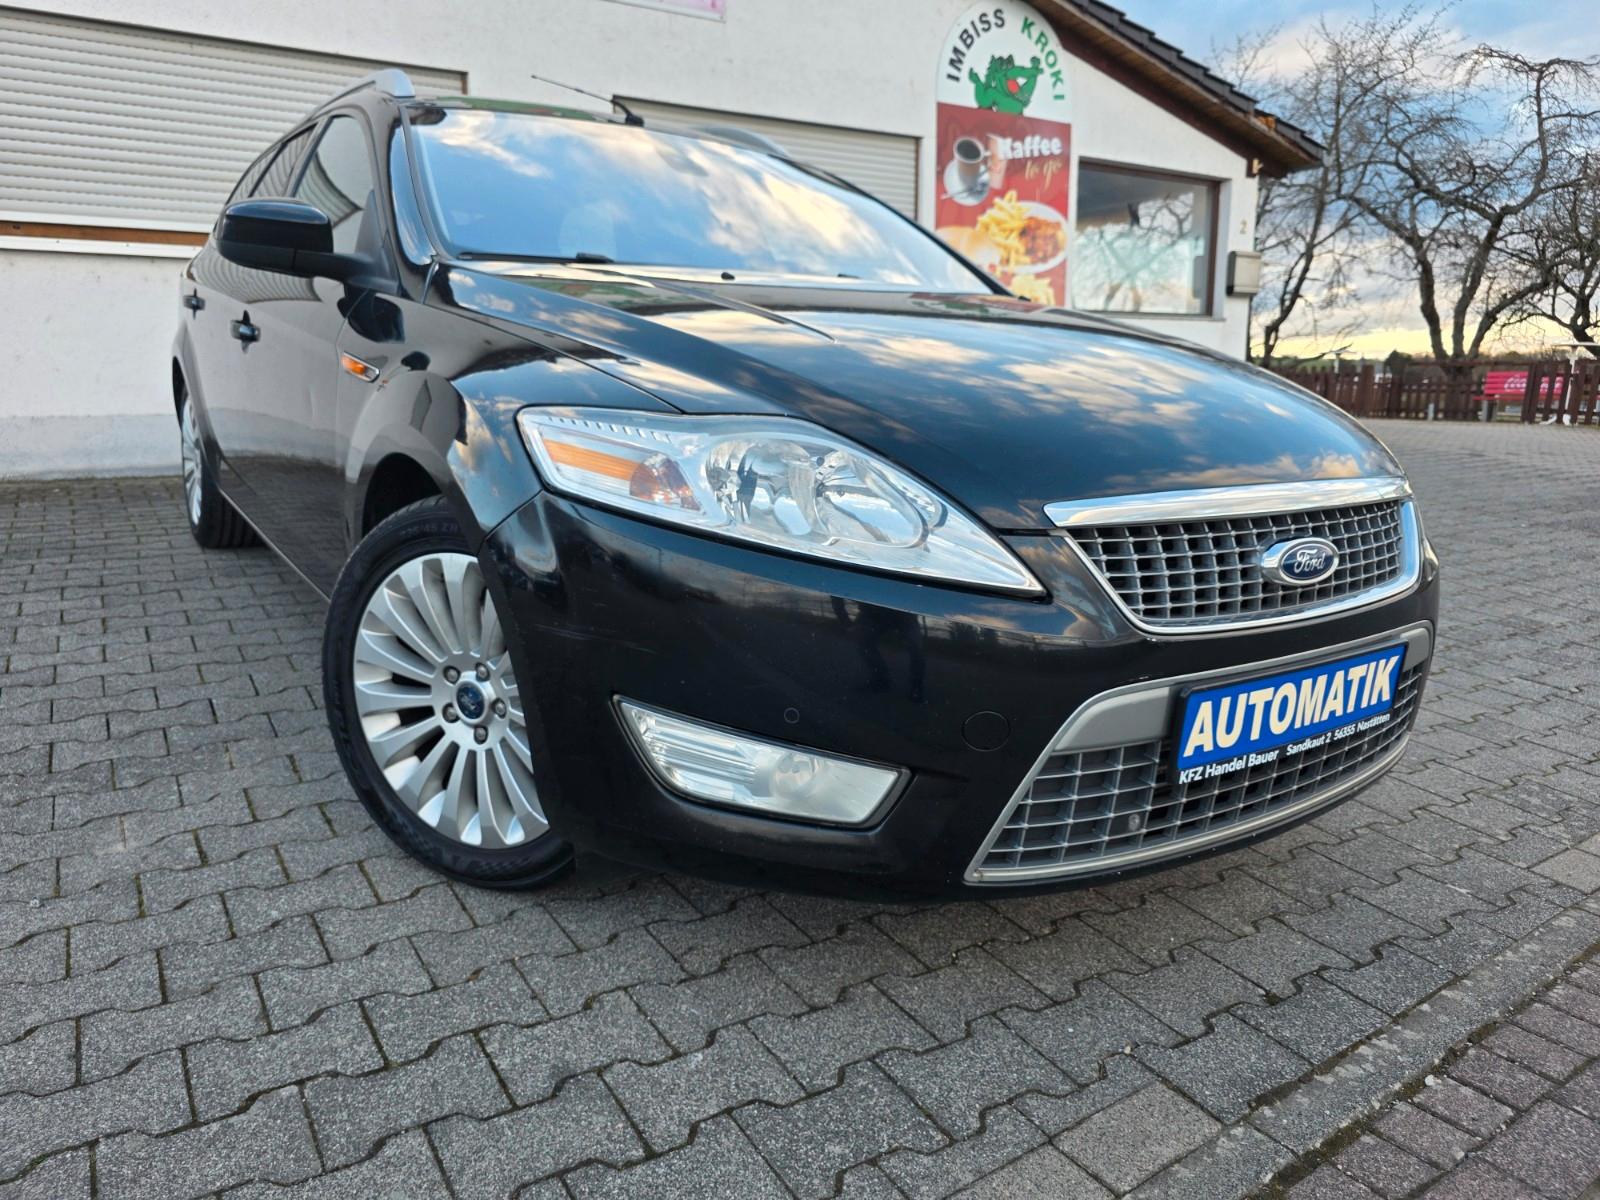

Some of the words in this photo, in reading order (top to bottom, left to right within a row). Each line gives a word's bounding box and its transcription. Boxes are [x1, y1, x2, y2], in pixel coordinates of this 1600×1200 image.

[946, 8, 1005, 83] IMBISS
[1020, 15, 1065, 101] KROKI
[999, 134, 1063, 160] Kaffee
[1293, 548, 1326, 574] Ford
[1182, 655, 1401, 758] AUTOMATIK
[1178, 765, 1204, 785] KFZ
[1204, 754, 1247, 778] Handel
[1247, 749, 1280, 767] Bauer
[1285, 736, 1326, 756] Sandkaut
[1324, 732, 1332, 744] 2
[1333, 723, 1356, 741] 56355
